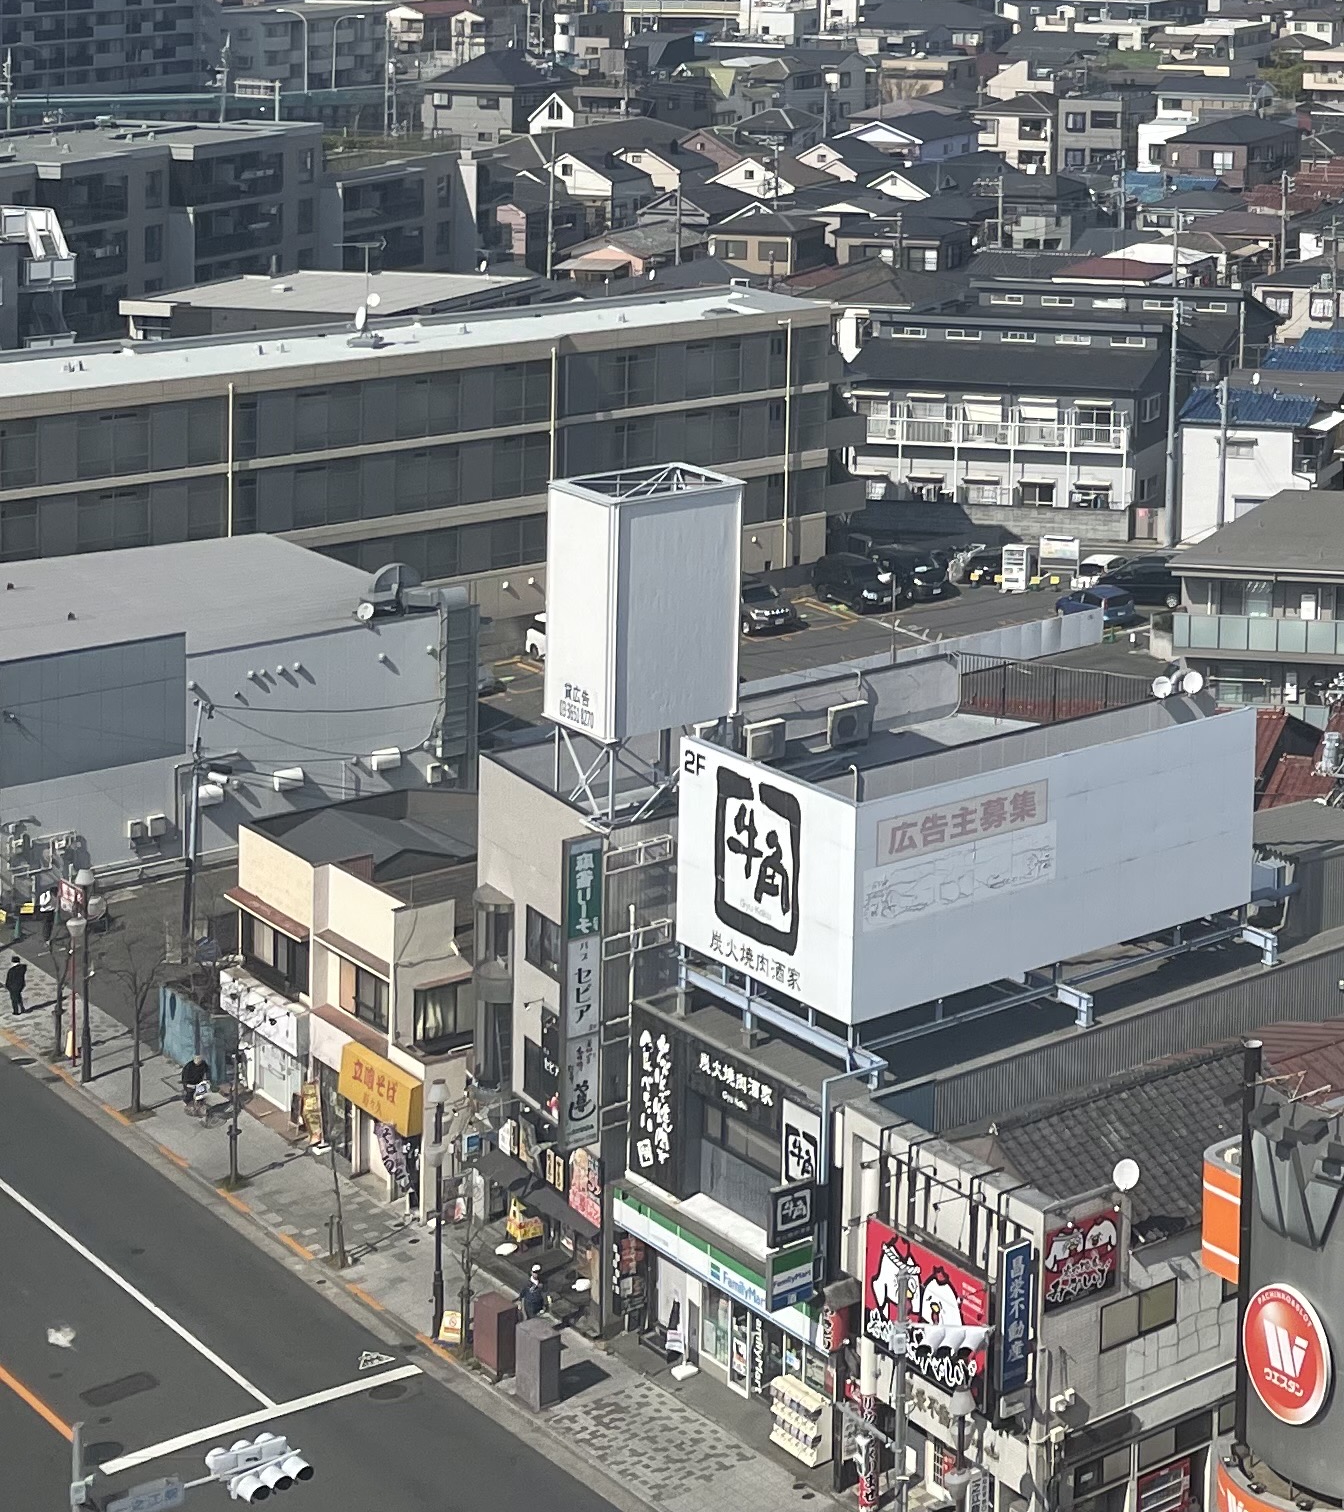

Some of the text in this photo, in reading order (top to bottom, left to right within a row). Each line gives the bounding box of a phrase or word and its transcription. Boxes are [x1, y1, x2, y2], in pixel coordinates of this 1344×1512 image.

[564, 683, 590, 708] 貸広告
[684, 749, 706, 775] 2F
[888, 790, 1037, 855] 広告主募集
[726, 803, 790, 916] 牛角
[709, 929, 802, 992] 炭火焼肉酒家
[574, 967, 592, 1025] セピア
[722, 1270, 766, 1308] FamilyMar
[773, 1269, 811, 1287] FamilyMart
[1263, 1366, 1304, 1397] ウエスタン
